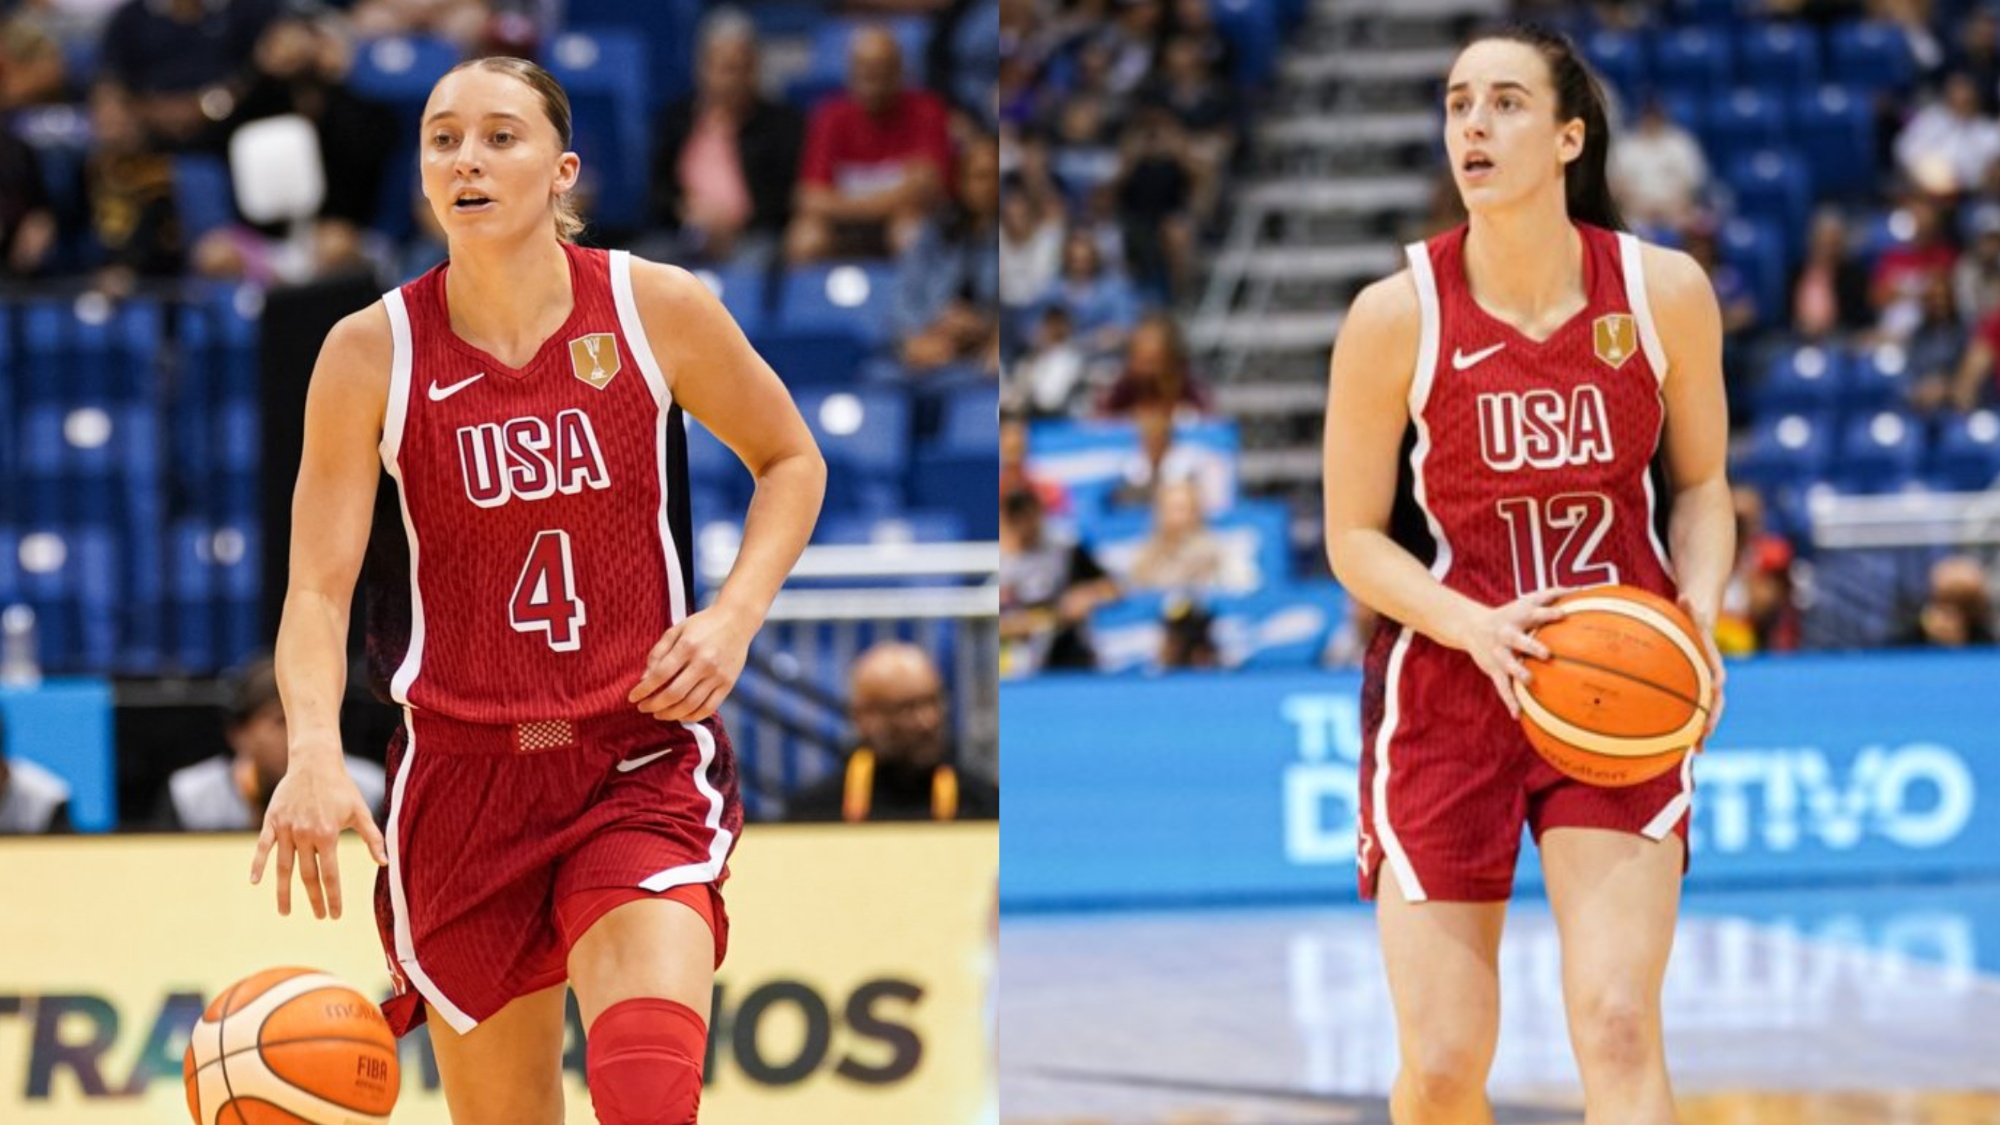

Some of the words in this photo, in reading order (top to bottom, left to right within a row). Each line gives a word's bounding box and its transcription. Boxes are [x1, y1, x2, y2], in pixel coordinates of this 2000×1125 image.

[456, 408, 611, 508] USA
[1477, 384, 1614, 472] USA
[509, 529, 586, 652] 4
[1496, 491, 1620, 600] 12
[357, 1054, 388, 1083] FIBA
